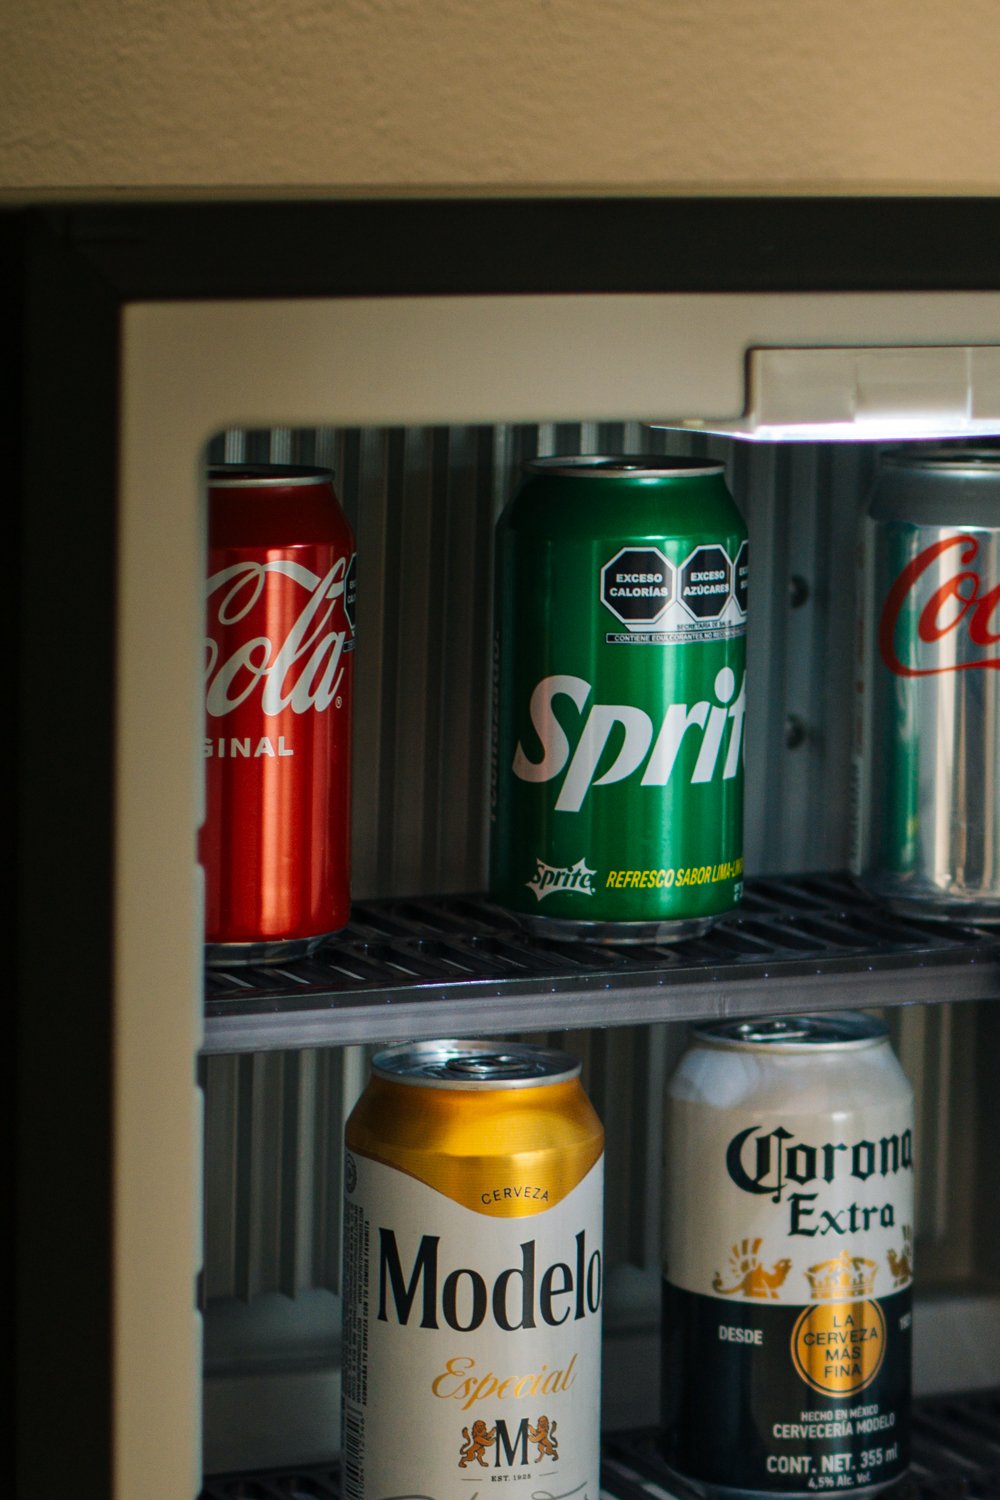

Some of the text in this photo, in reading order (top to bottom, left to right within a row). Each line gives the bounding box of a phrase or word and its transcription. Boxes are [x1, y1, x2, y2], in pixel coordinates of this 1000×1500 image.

[615, 573, 663, 583] EXCESO
[690, 570, 726, 582] EXCESO
[609, 586, 669, 597] CALORÍAS
[683, 583, 730, 596] AZÚCARES
[614, 634, 650, 642] CONTIENE
[512, 666, 746, 812] Sprit
[531, 865, 592, 889] Sprite
[605, 869, 674, 888] REFRESCO
[675, 866, 711, 886] SABOR
[726, 1126, 912, 1204] Corona
[481, 1186, 549, 1204] CERVEZA
[787, 1192, 895, 1237] Extra
[377, 1227, 601, 1332] Modelo
[833, 1314, 855, 1328] LA
[718, 1325, 763, 1345] DESDE
[803, 1327, 879, 1346] CERVEZA
[826, 1344, 861, 1362] MÁS
[824, 1363, 862, 1379] FINA
[432, 1353, 578, 1410] Especial
[801, 1404, 879, 1422] HECHO EN MÉXICO
[773, 1412, 895, 1438] CERVECERÍA MODELO
[494, 1418, 529, 1467] M
[766, 1442, 898, 1473] CONT. NET. 355 ml
[513, 1473, 532, 1481] 1925
[808, 1476, 834, 1489] 4,5%
[836, 1474, 854, 1486] Alc.
